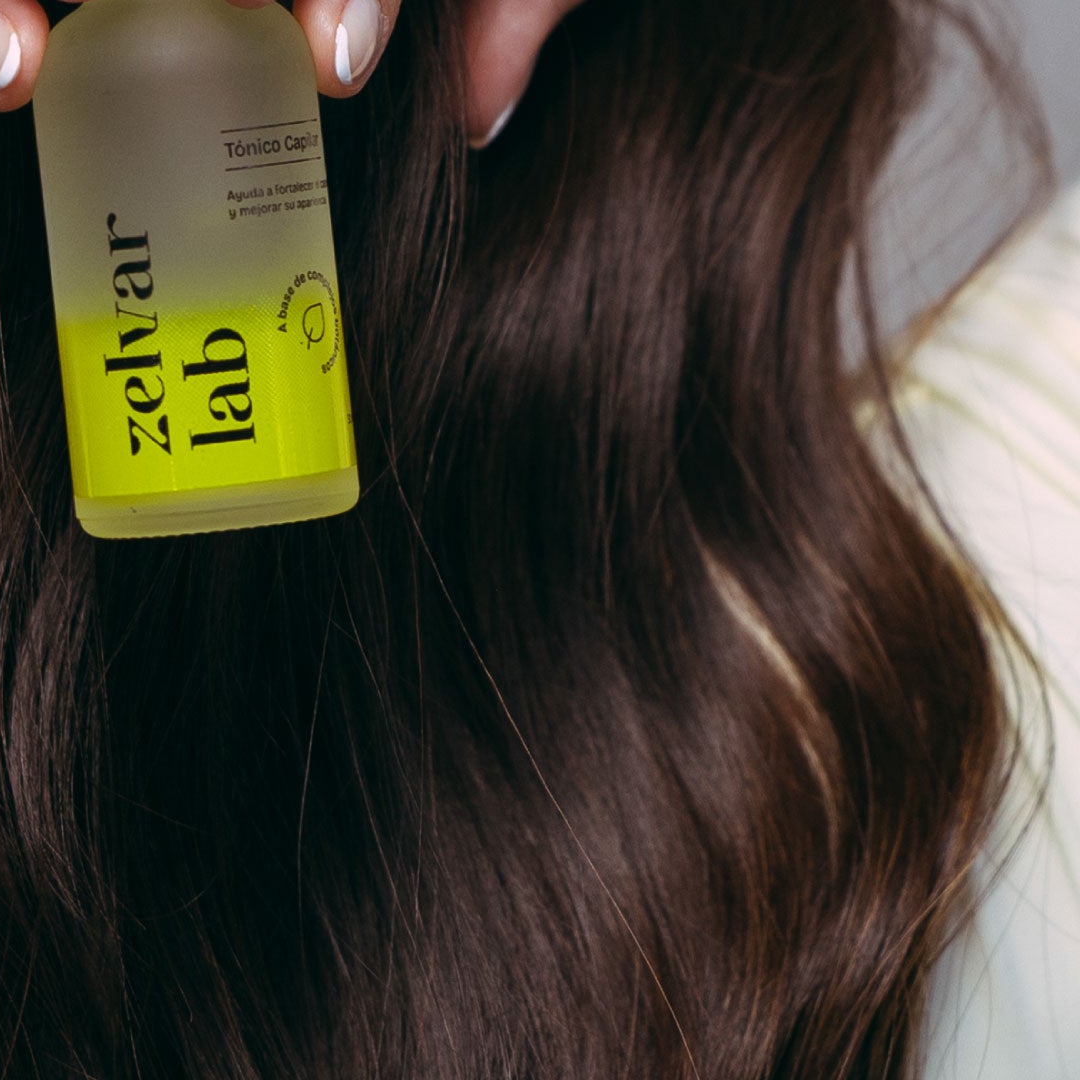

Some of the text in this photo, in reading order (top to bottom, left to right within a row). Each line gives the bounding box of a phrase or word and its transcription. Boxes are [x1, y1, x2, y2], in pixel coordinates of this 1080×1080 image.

[223, 138, 281, 158] Tónico
[227, 187, 265, 202] Ayuda
[266, 188, 273, 197] a
[228, 208, 237, 220] y
[239, 201, 282, 217] mejorar
[284, 201, 296, 211] su
[277, 273, 307, 333] A base de
[103, 212, 172, 456] zelvar
[181, 327, 256, 451] lab
